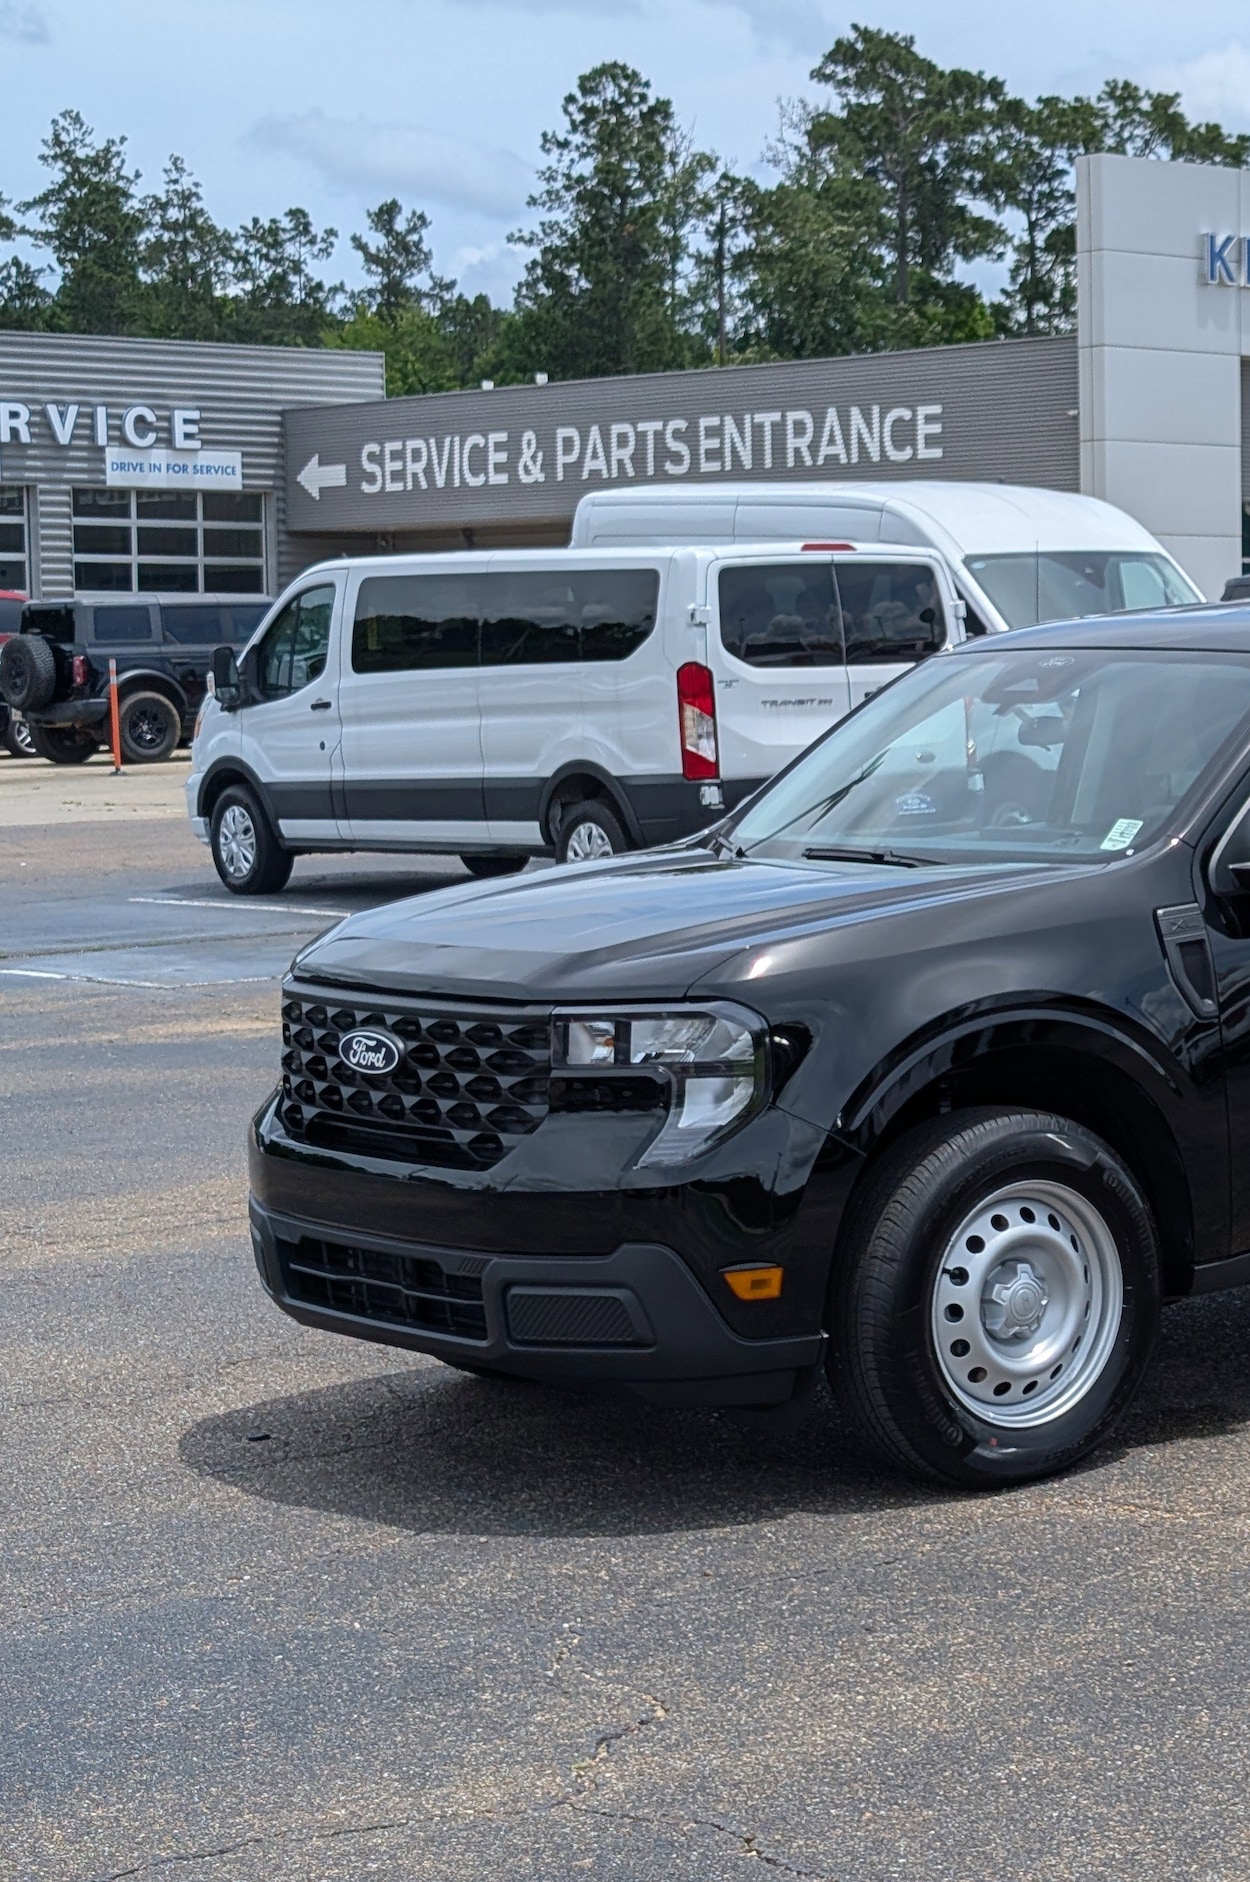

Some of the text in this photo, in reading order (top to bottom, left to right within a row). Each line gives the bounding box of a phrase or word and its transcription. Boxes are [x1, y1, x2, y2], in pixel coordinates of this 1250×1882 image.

[0, 402, 202, 450] RVICE
[111, 461, 237, 476] DRIVE IN FOR SERVICE
[360, 404, 944, 494] SERVICE & PARTS ENTRANCE
[349, 1036, 386, 1068] Ford
